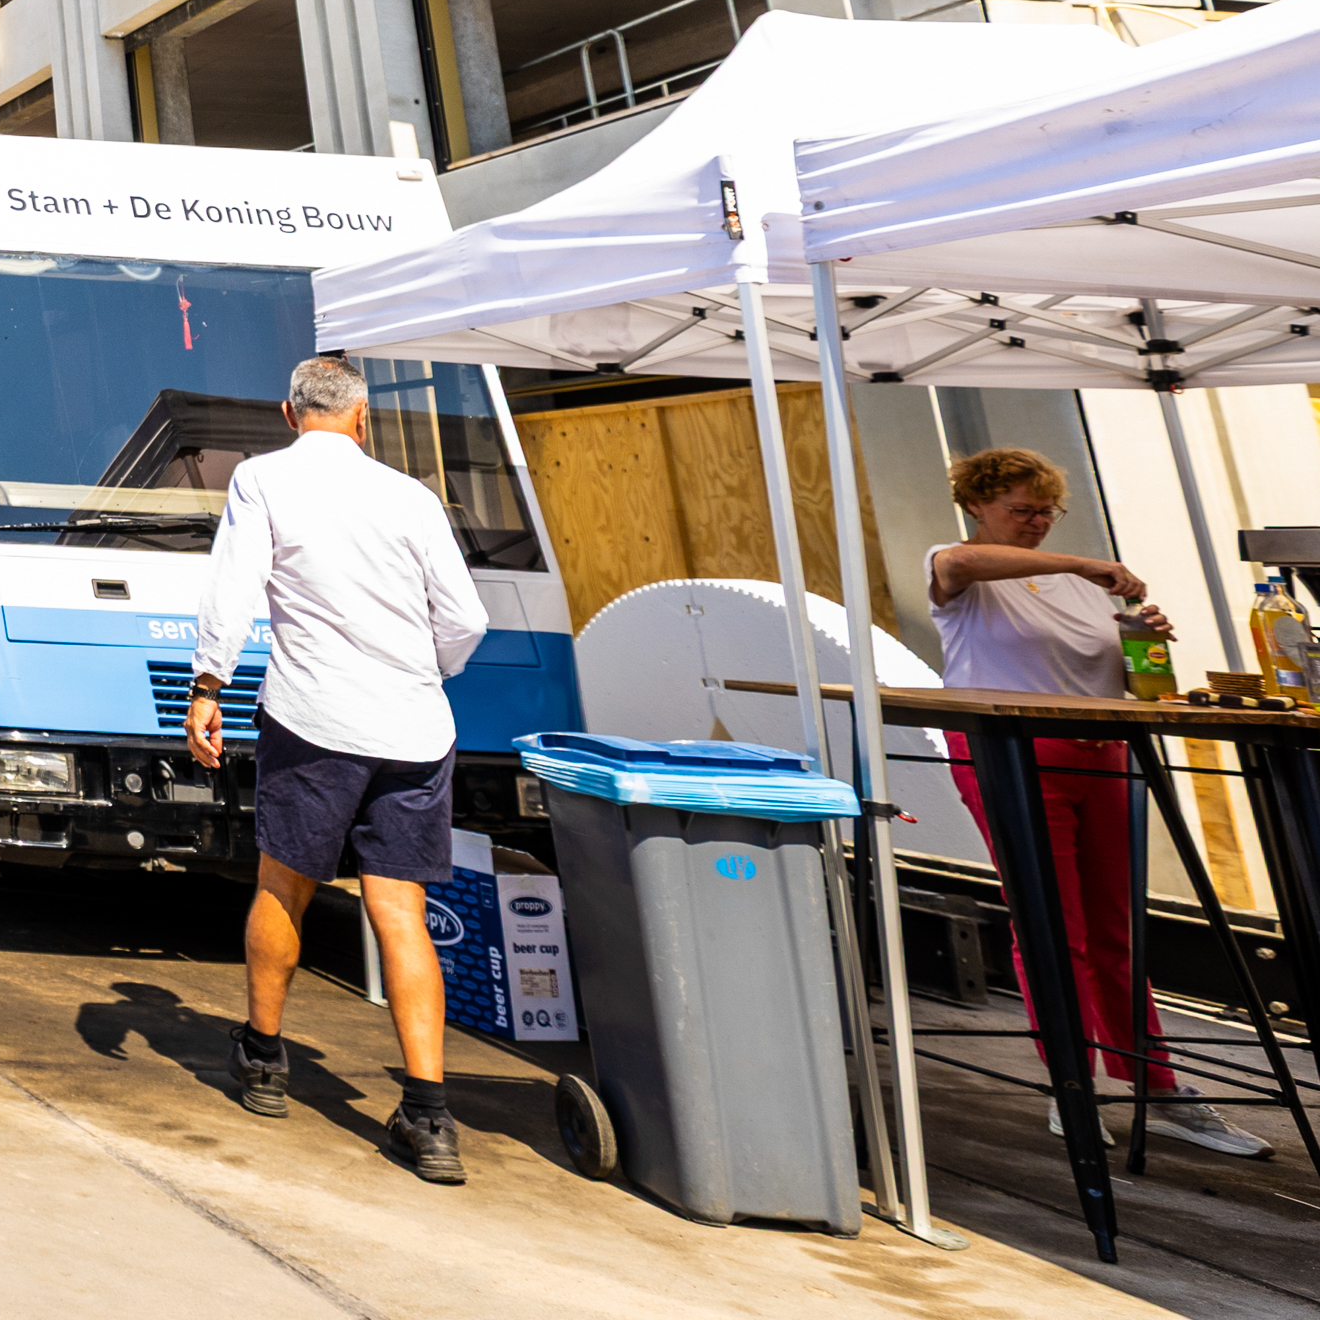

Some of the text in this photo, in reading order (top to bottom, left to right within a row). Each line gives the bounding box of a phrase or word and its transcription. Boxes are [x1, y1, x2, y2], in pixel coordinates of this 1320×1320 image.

[7, 187, 393, 234] Stam + De Koning Bouw
[513, 943, 560, 956] beer cup
[489, 946, 509, 1028] beer cup
